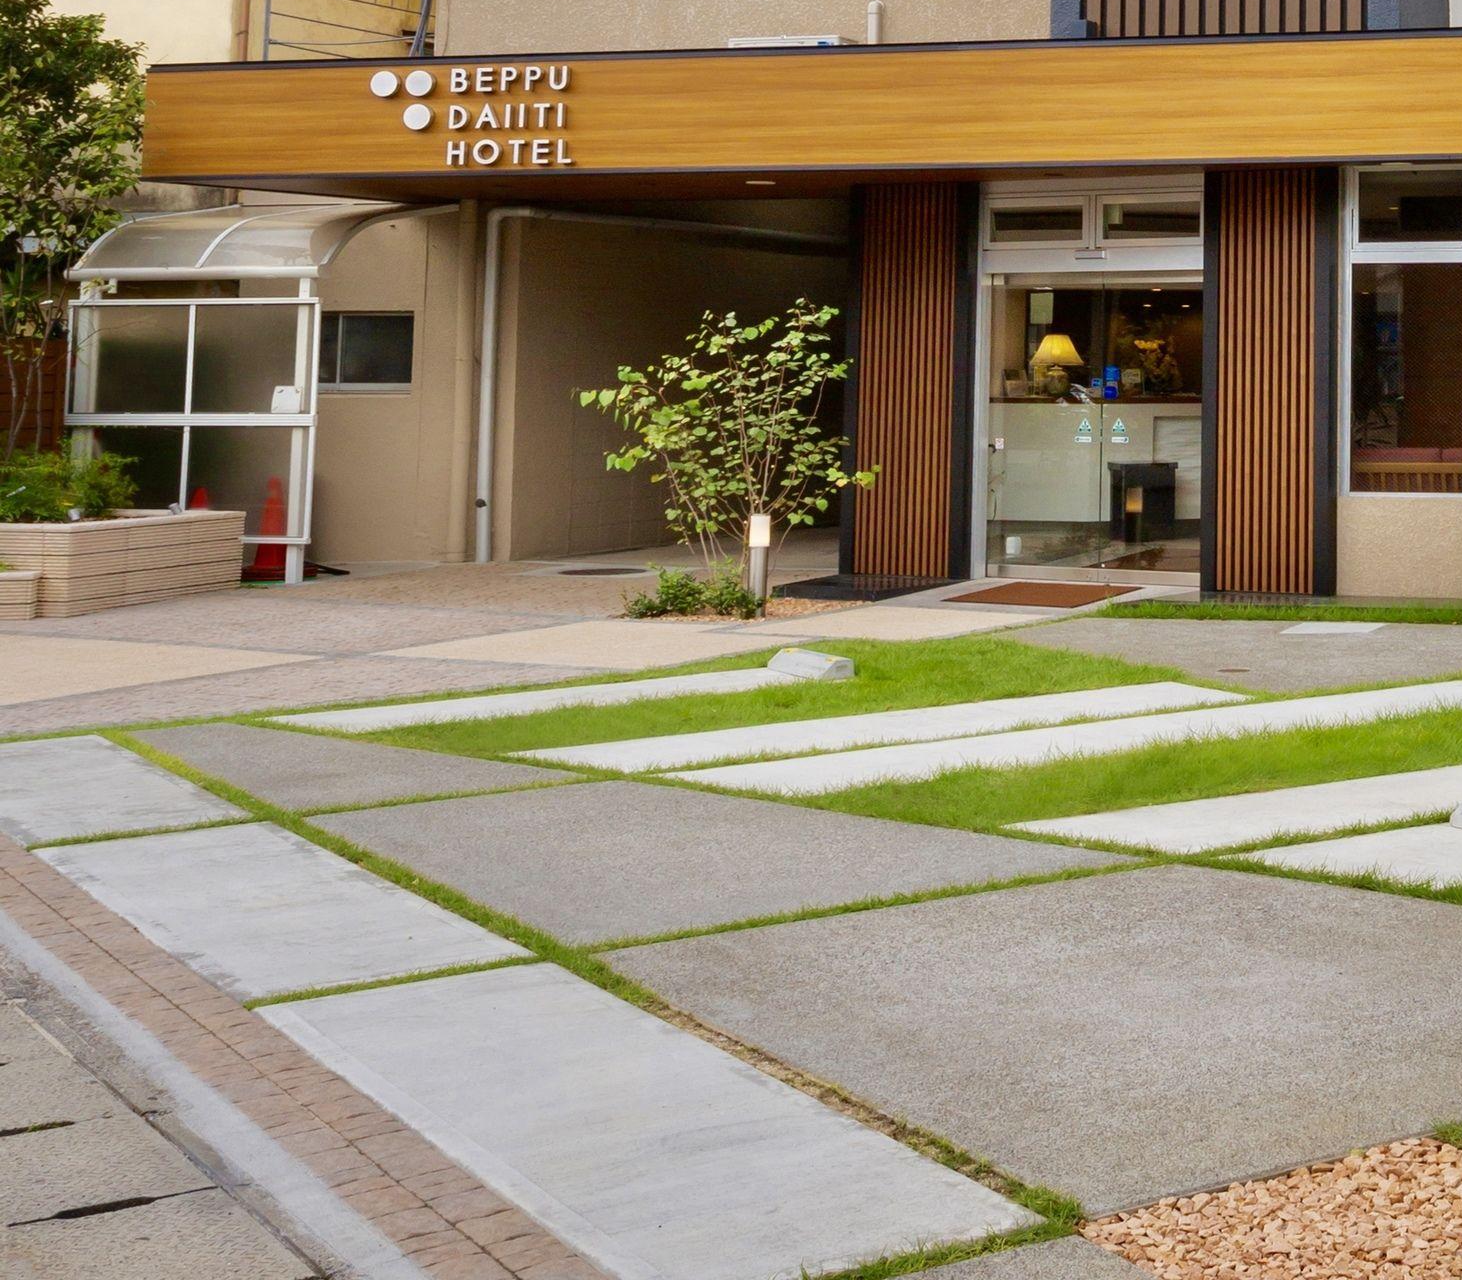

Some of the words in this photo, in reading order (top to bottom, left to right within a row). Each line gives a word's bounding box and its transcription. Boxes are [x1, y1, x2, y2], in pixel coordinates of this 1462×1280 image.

[450, 65, 570, 94] BEPPU
[448, 102, 567, 130] DAIITI
[446, 138, 572, 166] HOTEL
